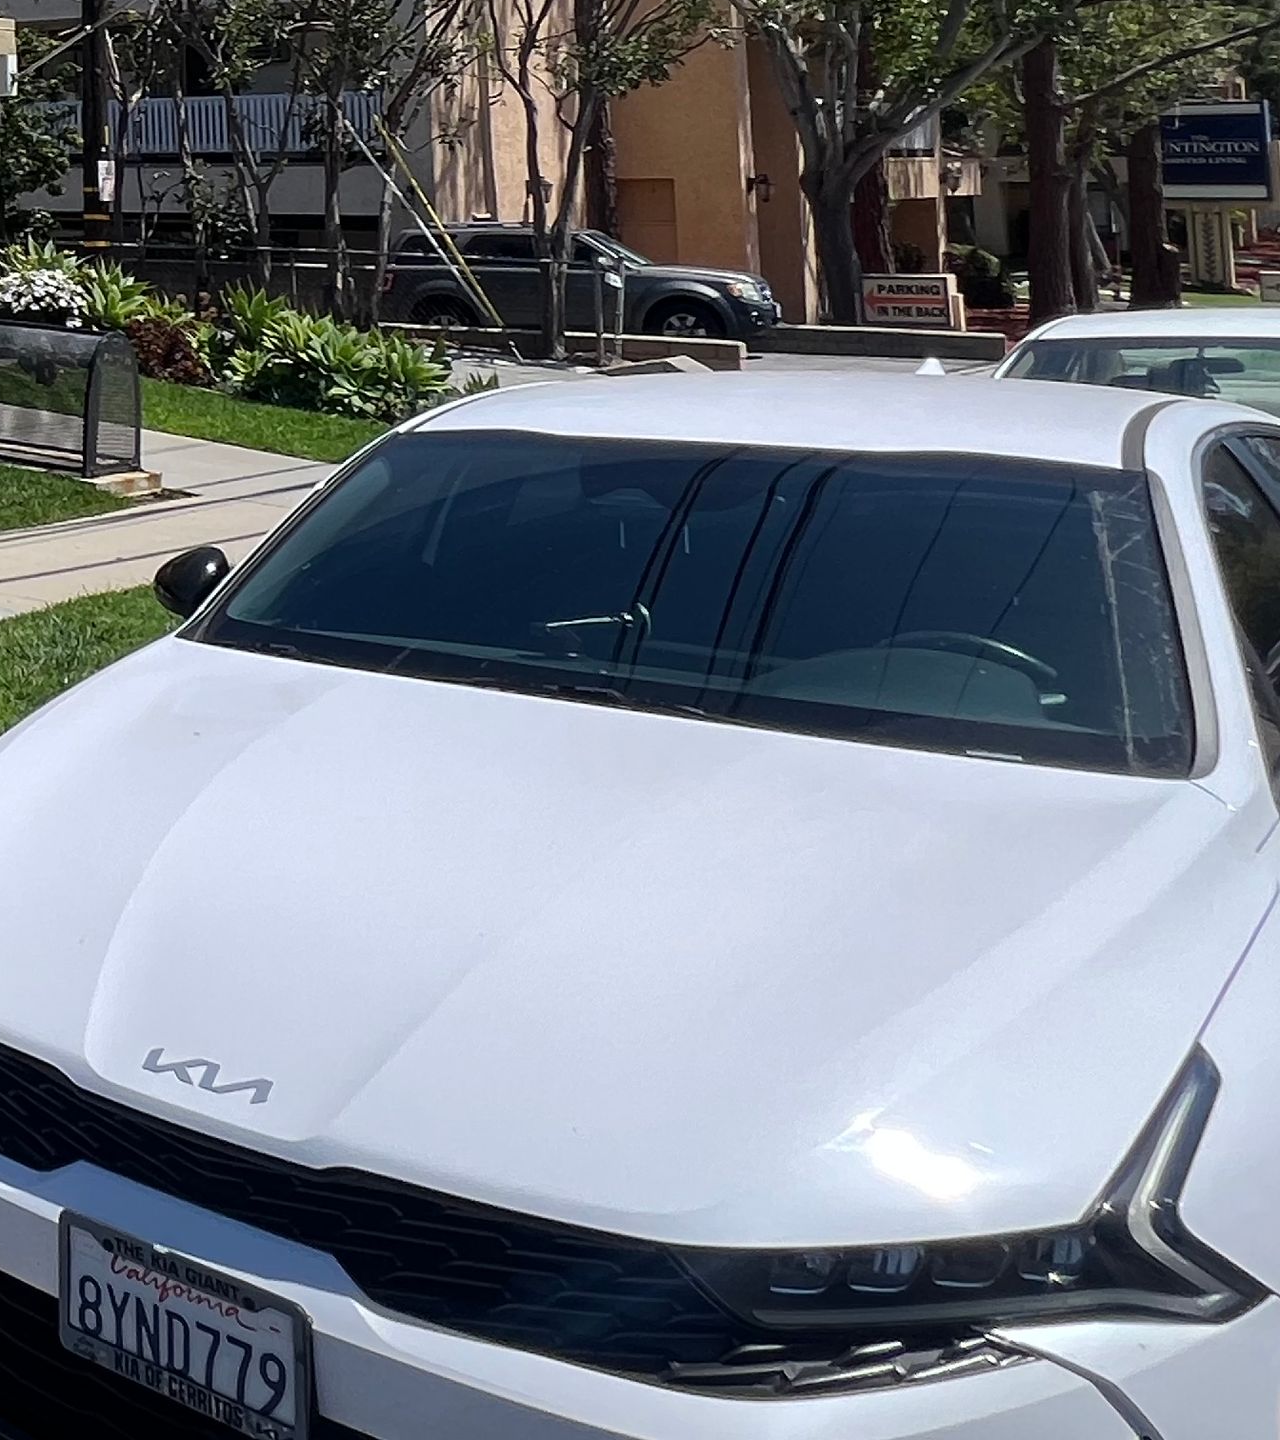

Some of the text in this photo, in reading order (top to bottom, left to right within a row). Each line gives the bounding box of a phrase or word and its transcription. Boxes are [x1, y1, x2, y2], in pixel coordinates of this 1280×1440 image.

[1162, 141, 1259, 153] UNTINGTON
[877, 284, 940, 295] PARKING
[916, 306, 947, 317] BACK
[110, 1254, 256, 1331] California
[114, 1237, 240, 1299] THE KIA GIANT
[79, 1275, 286, 1415] 8YND779
[114, 1350, 244, 1428] KIA OF CERRITOS
